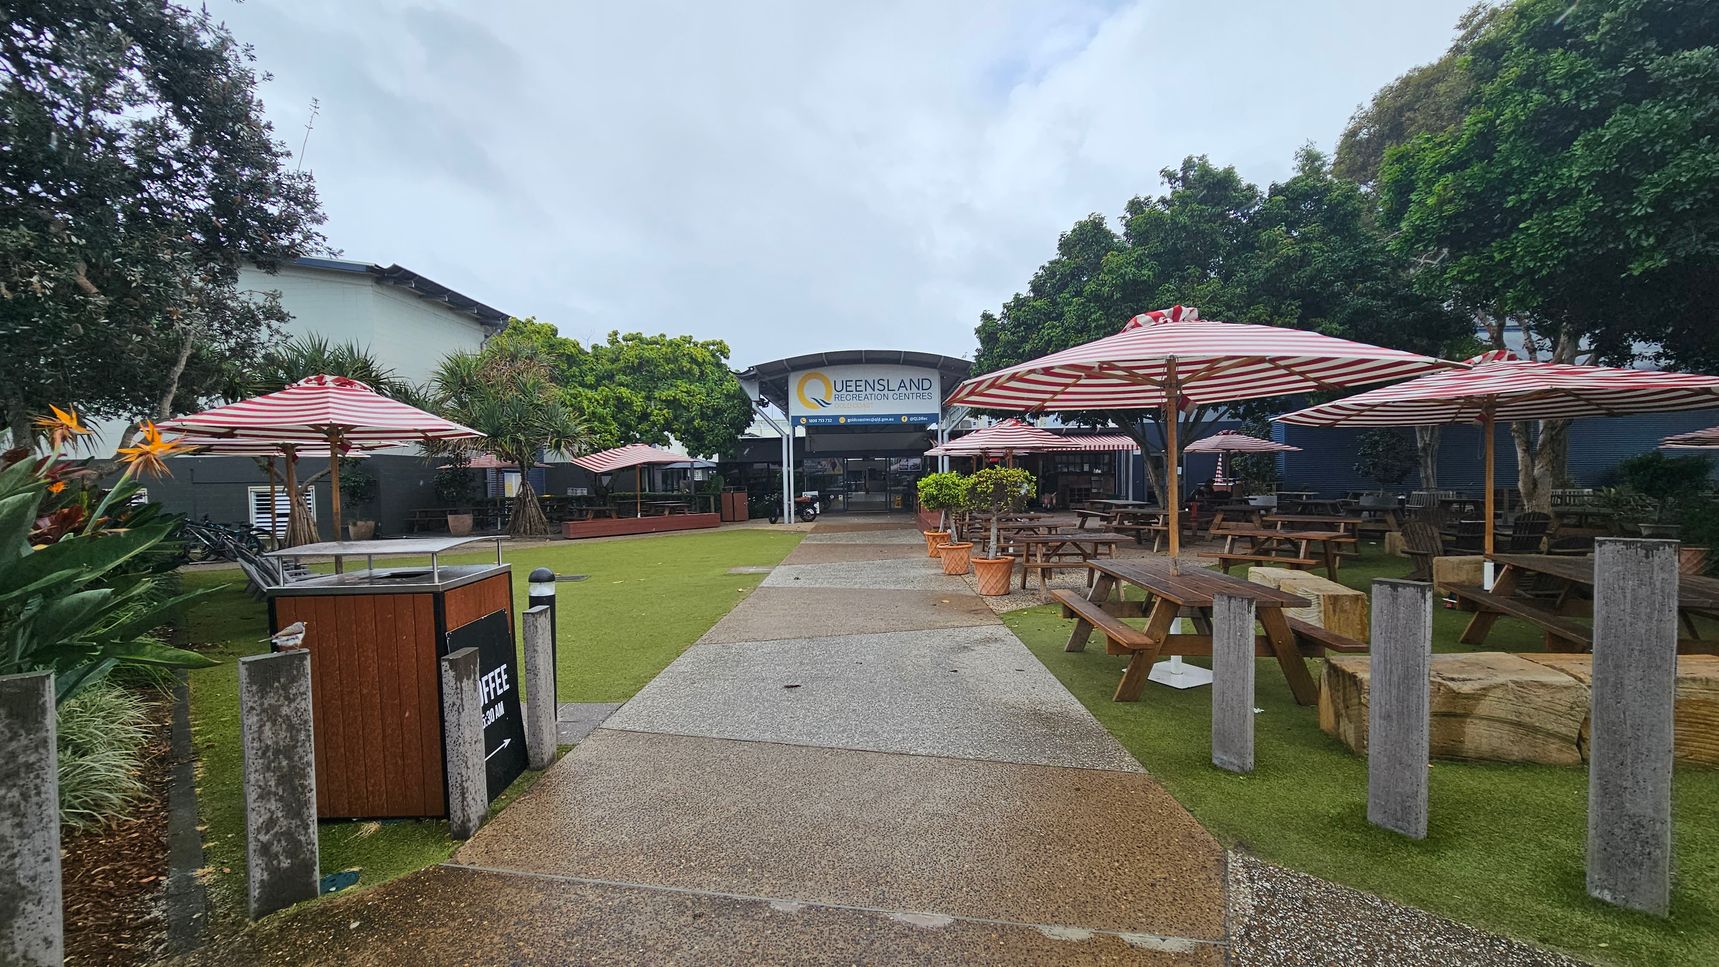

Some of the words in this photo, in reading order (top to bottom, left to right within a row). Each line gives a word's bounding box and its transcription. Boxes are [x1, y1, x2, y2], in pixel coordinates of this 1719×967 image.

[797, 372, 932, 410] QUEENSLAND
[834, 393, 889, 402] RECREATION
[892, 392, 932, 401] CENTRES
